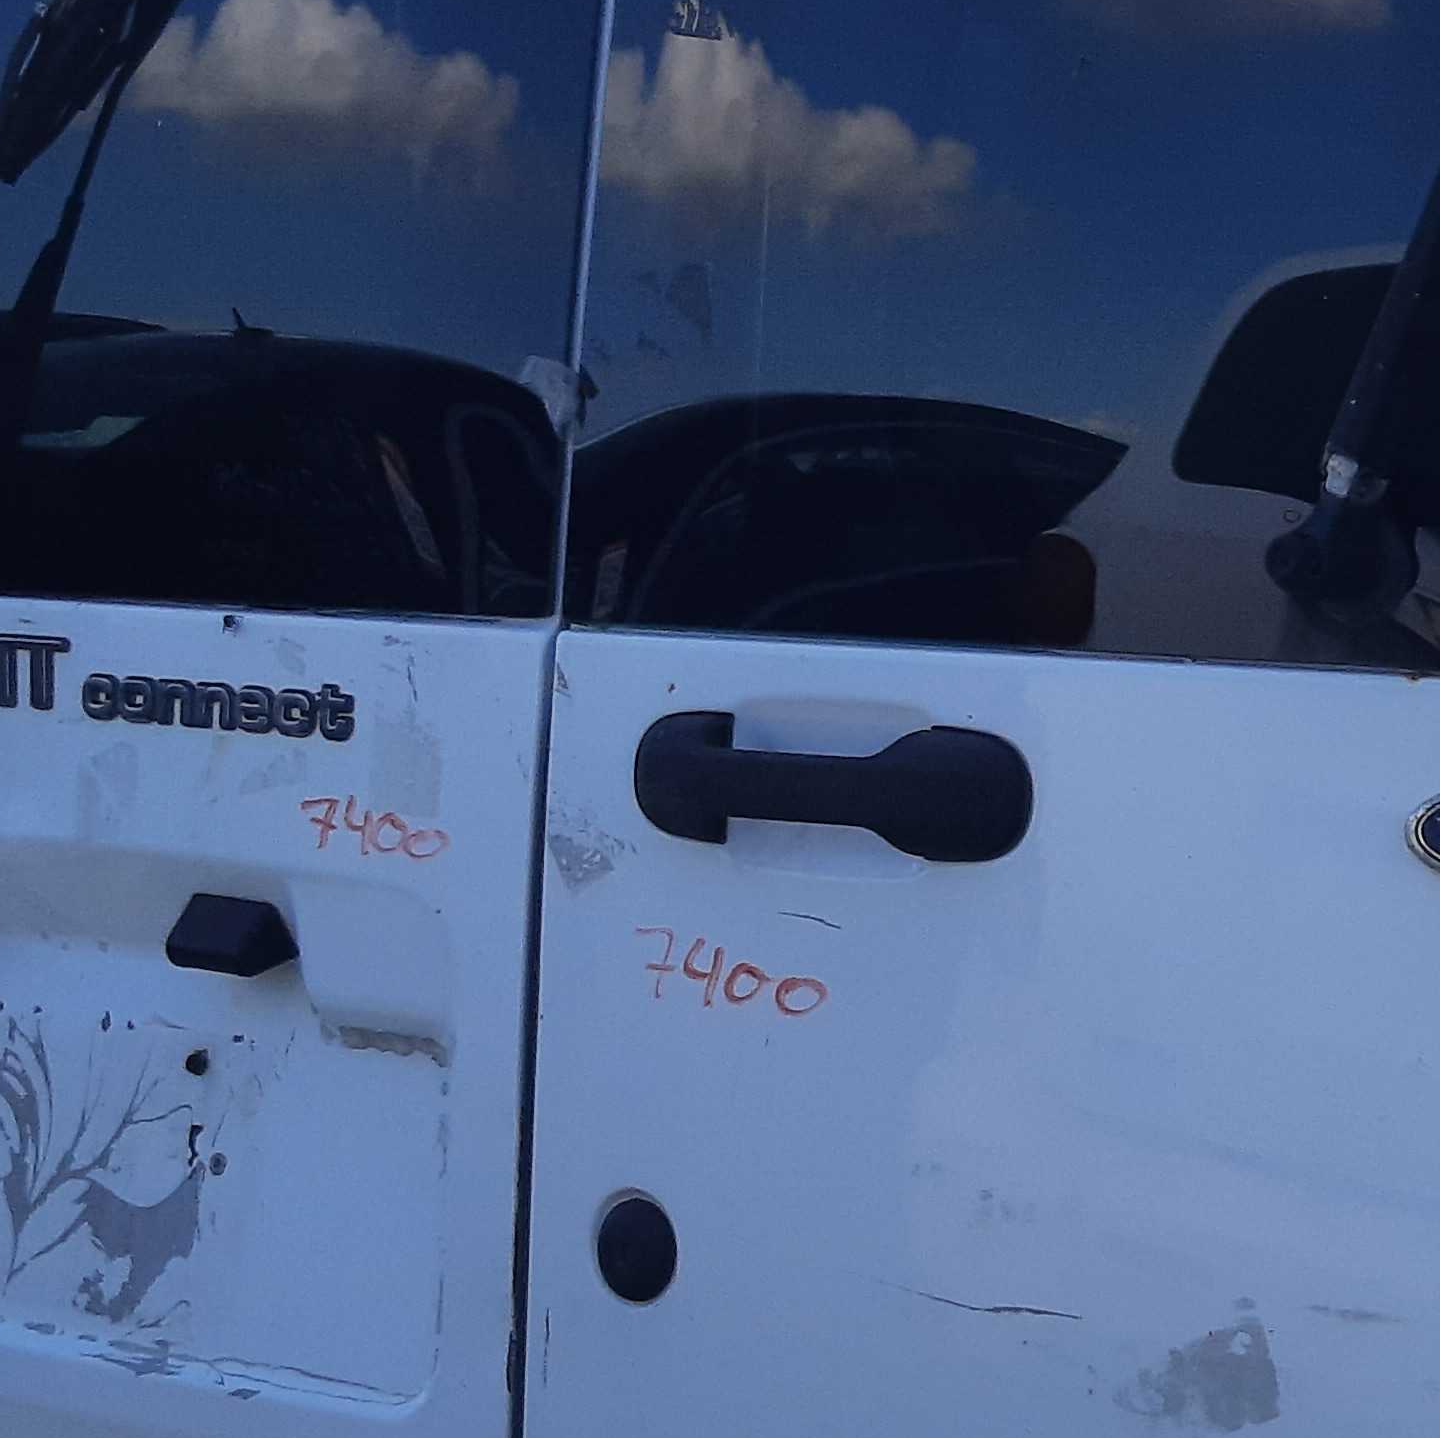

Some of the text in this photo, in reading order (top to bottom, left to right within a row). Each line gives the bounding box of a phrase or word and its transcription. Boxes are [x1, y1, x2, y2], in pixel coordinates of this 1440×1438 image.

[81, 671, 357, 742] connect
[300, 794, 450, 860] 7400
[634, 926, 829, 1016] 7400
